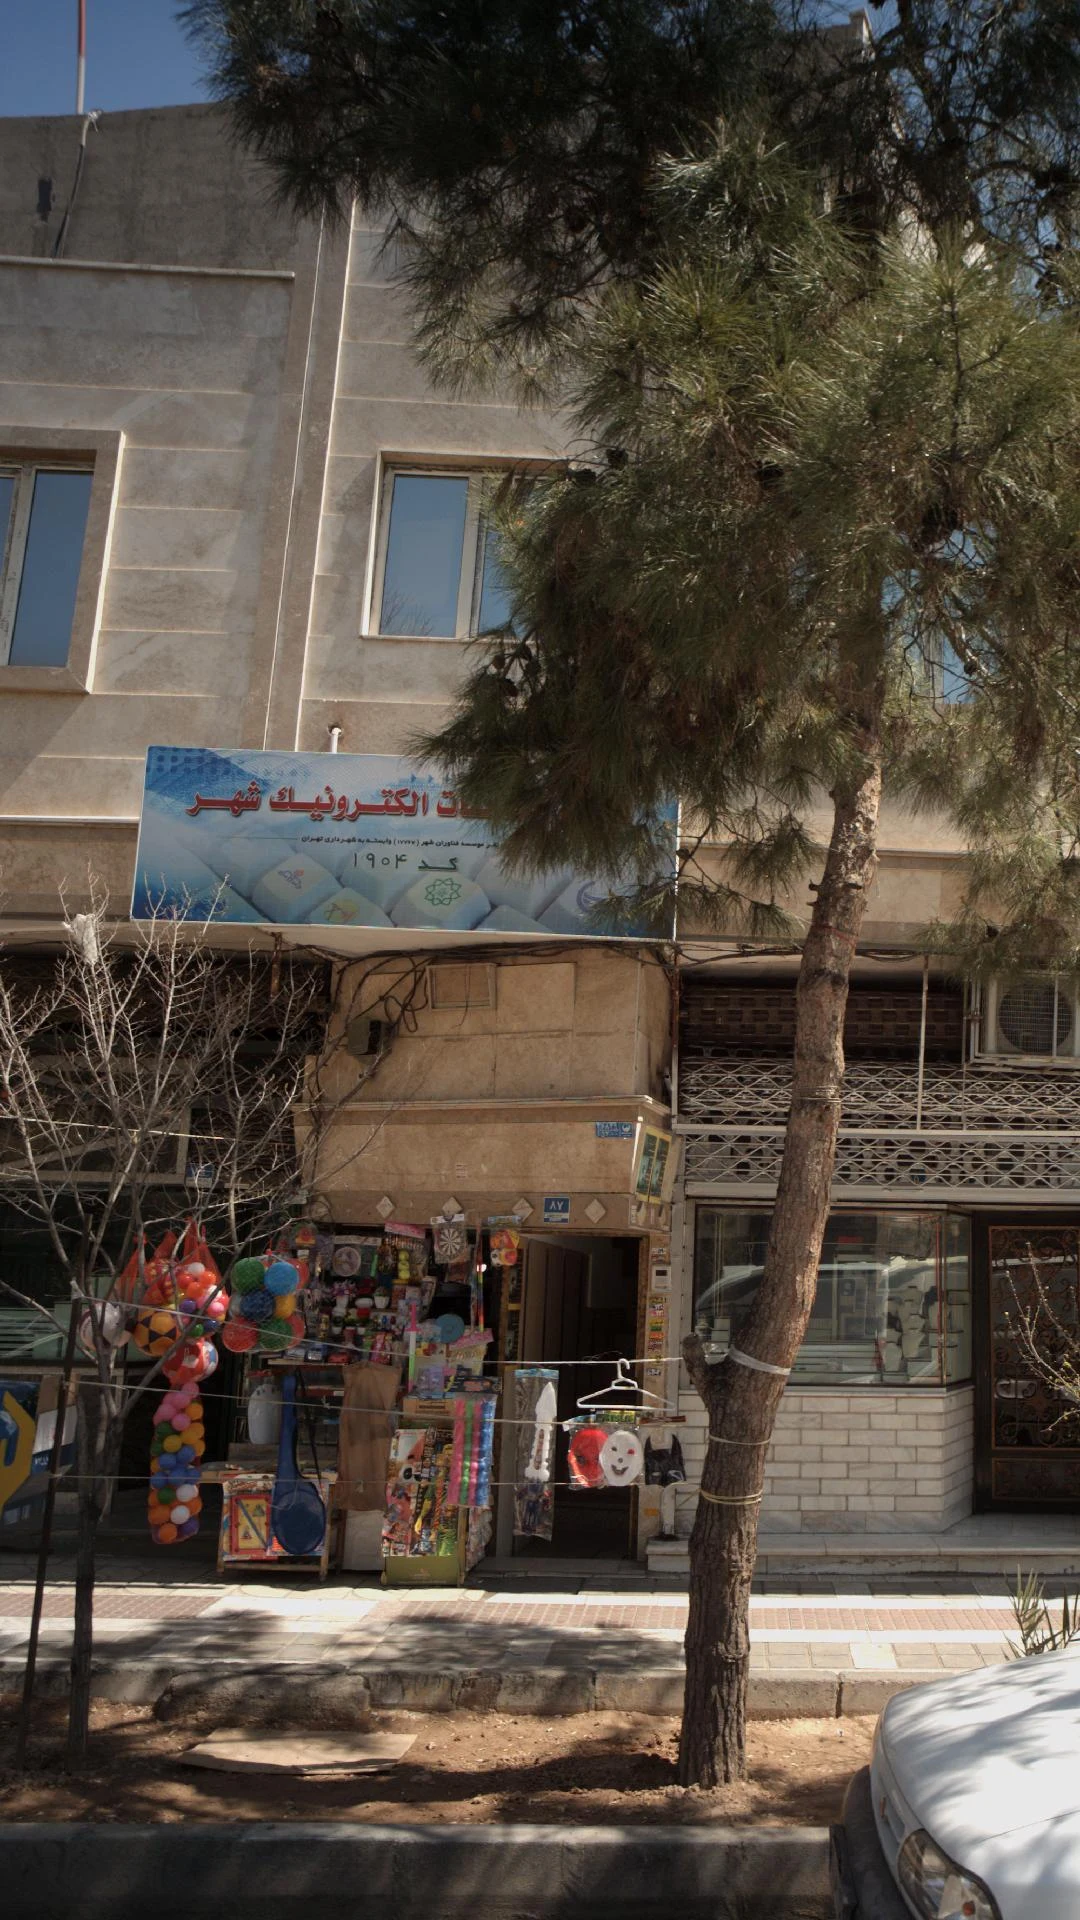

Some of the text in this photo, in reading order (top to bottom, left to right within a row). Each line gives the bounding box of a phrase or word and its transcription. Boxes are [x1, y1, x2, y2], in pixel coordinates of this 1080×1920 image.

[185, 780, 262, 817] شهر
[301, 834, 324, 844] تهران
[353, 852, 459, 873] کد ۱۹۰۴
